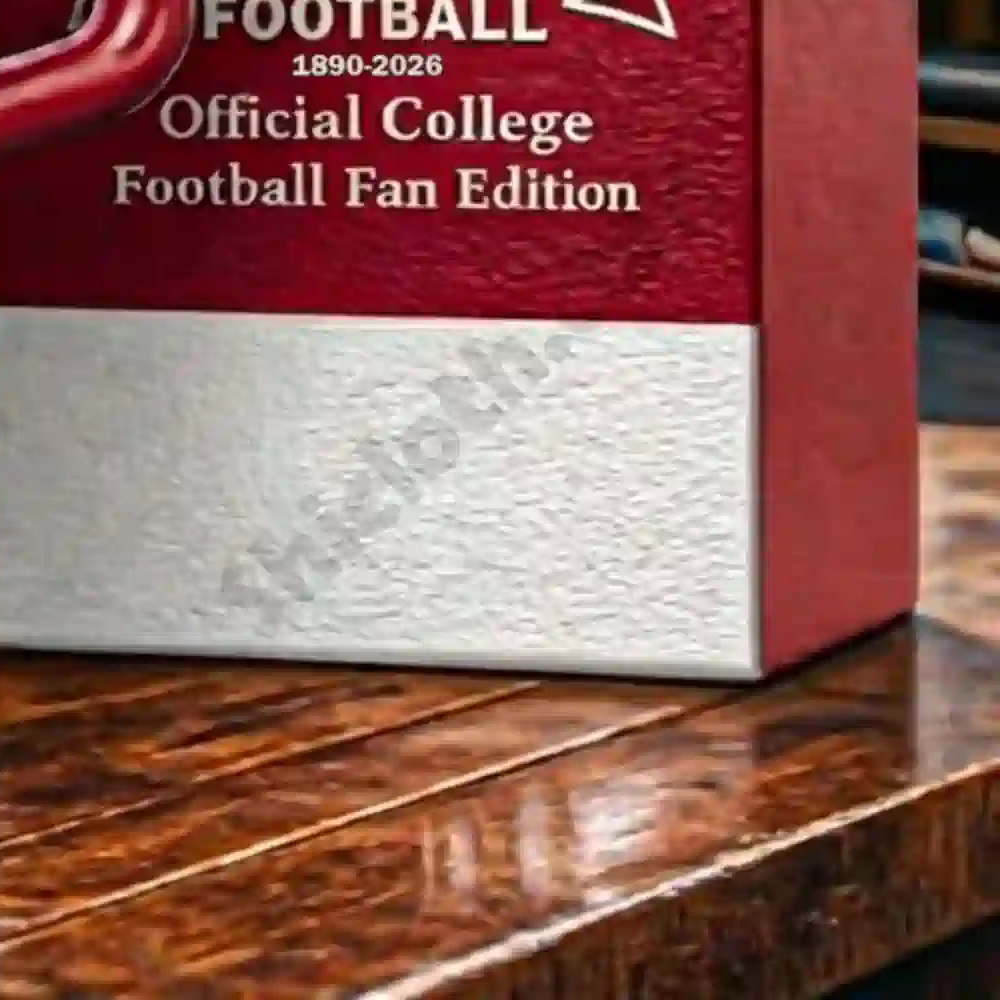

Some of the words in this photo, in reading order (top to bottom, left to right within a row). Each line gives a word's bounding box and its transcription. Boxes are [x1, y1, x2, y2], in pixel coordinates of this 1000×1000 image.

[292, 53, 443, 77] 1890-2026
[160, 93, 362, 140] Official
[382, 94, 594, 156] College
[114, 162, 325, 206] Football
[345, 167, 437, 209] Fan
[455, 164, 641, 212] Edition
